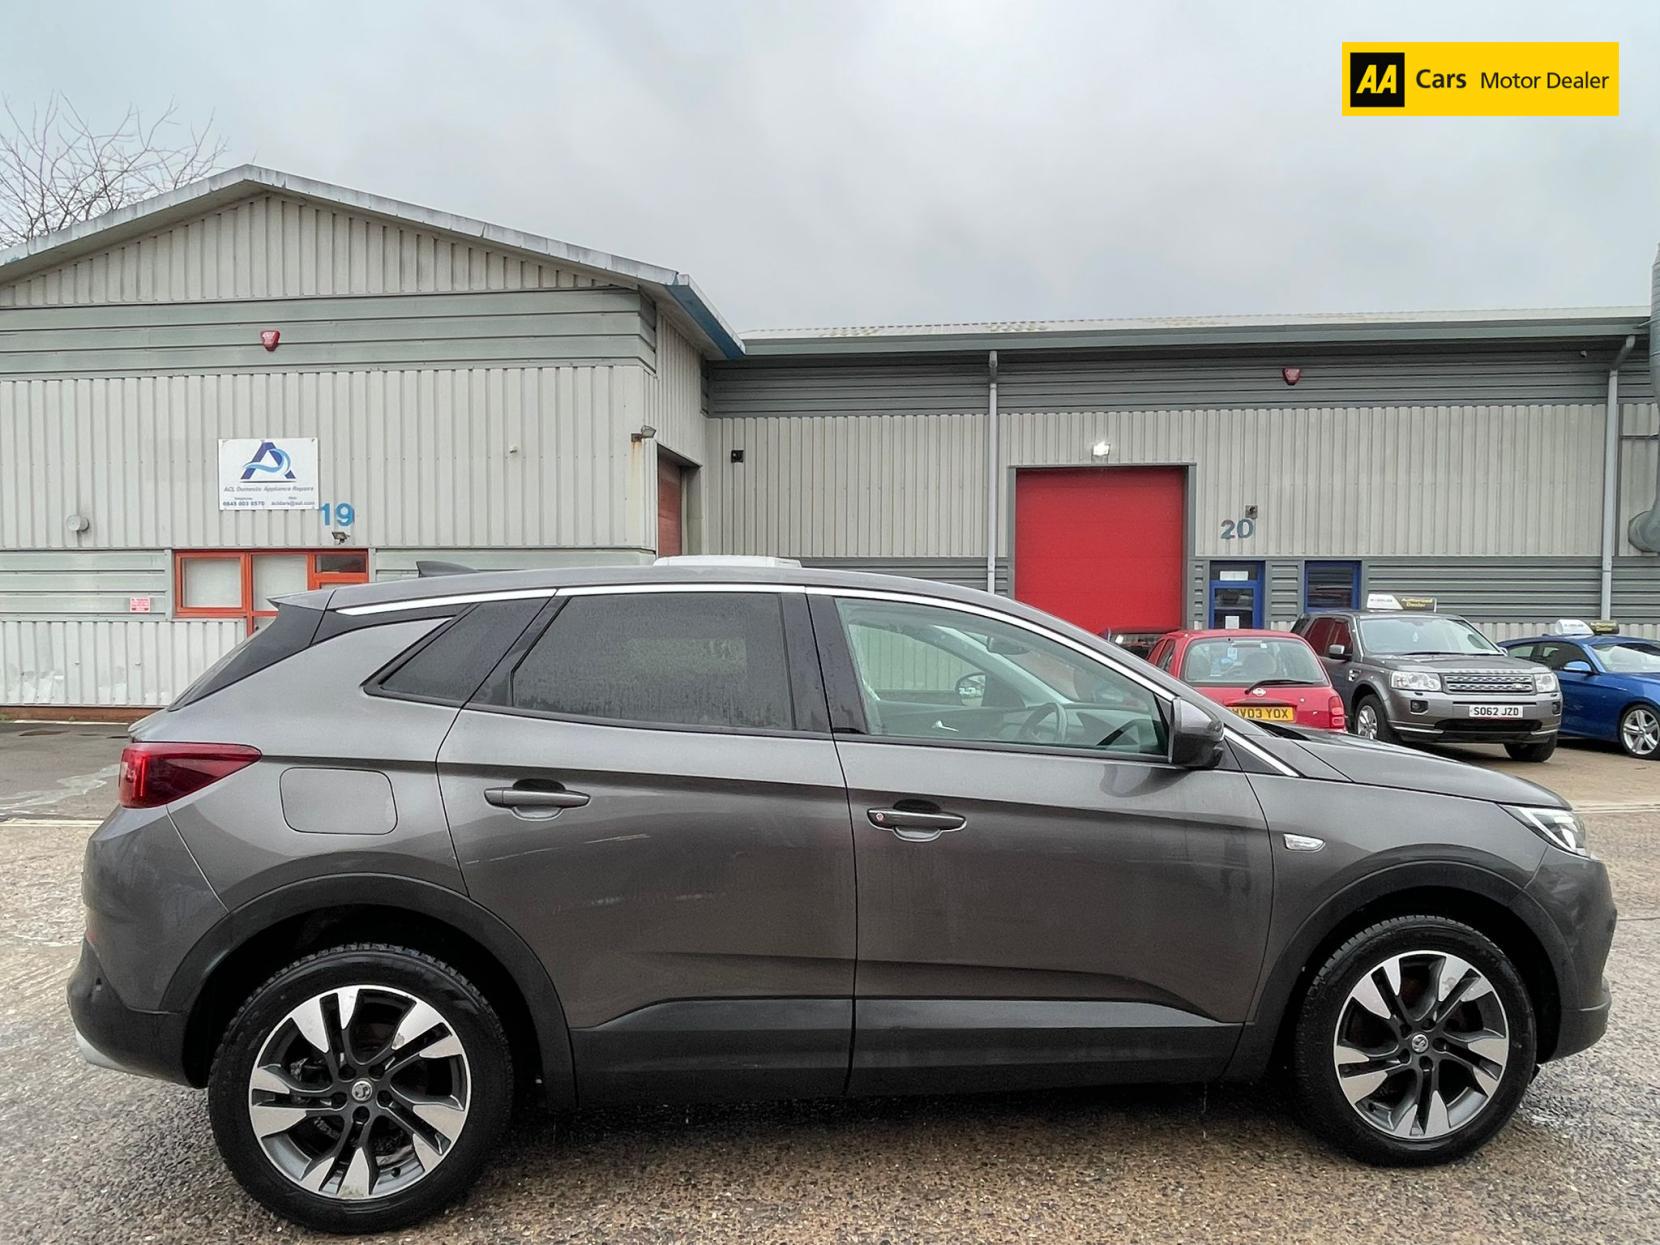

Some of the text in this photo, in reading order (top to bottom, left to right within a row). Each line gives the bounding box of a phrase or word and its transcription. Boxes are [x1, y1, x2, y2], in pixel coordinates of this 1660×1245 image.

[320, 502, 355, 527] 19
[1220, 519, 1254, 540] 20
[1265, 708, 1289, 719] YOX
[1501, 707, 1519, 716] JZD
